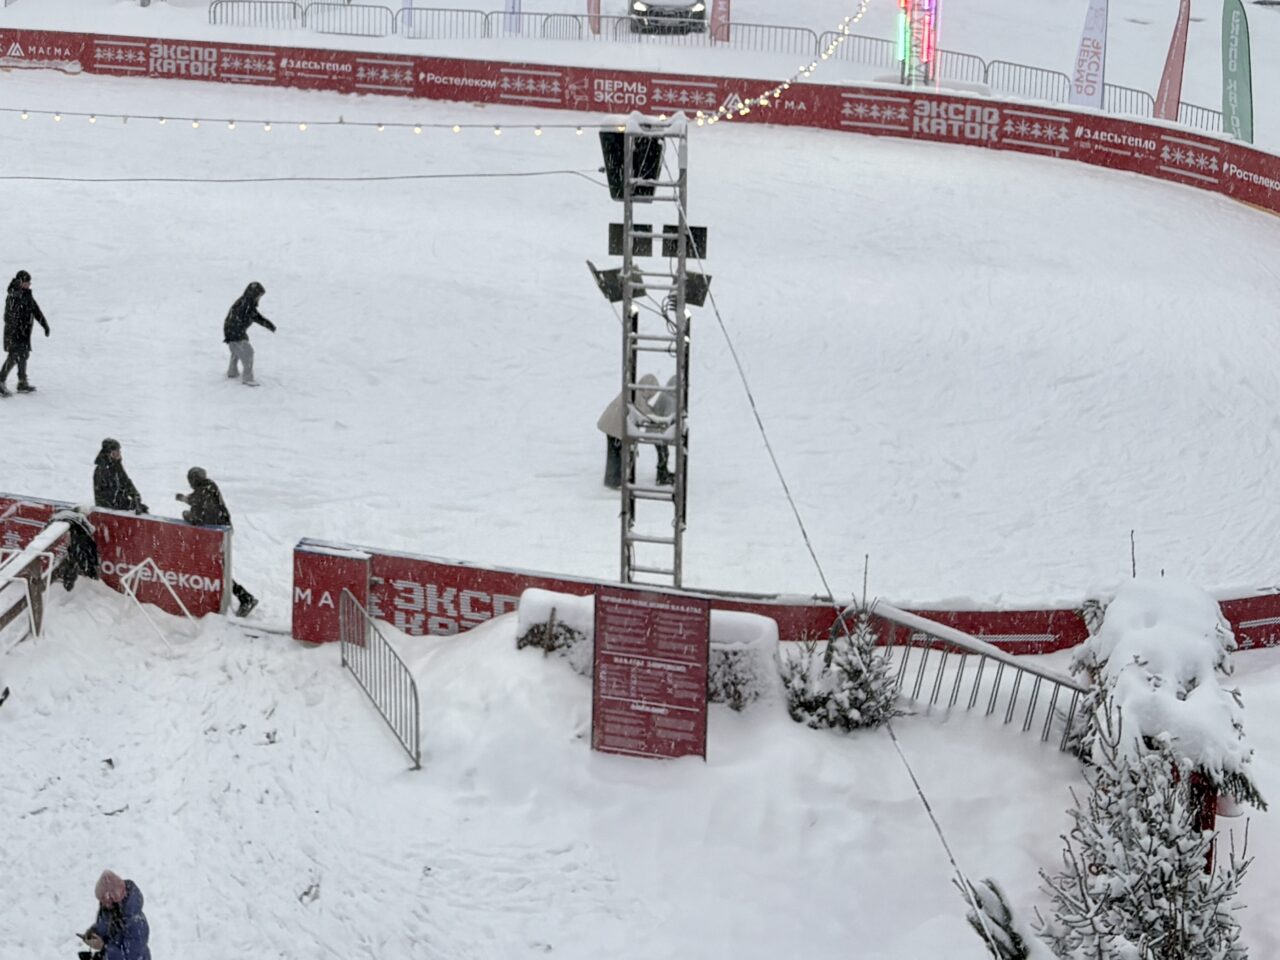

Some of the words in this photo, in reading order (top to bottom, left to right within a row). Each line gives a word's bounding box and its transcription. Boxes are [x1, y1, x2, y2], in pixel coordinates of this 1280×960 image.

[28, 45, 71, 57] МАГМА
[149, 43, 217, 63] ЭКСПО
[149, 59, 217, 77] КАТОК
[426, 73, 497, 90] Ростелеком
[593, 78, 647, 94] ПЕРМЬ
[593, 90, 648, 106] ЭКСПО
[913, 99, 1000, 125] ЭКСПО
[912, 116, 1000, 142] КАТОК
[1229, 163, 1280, 191] Ростелеко
[101, 560, 220, 592] остелеком
[393, 578, 520, 622] ЭКСП
